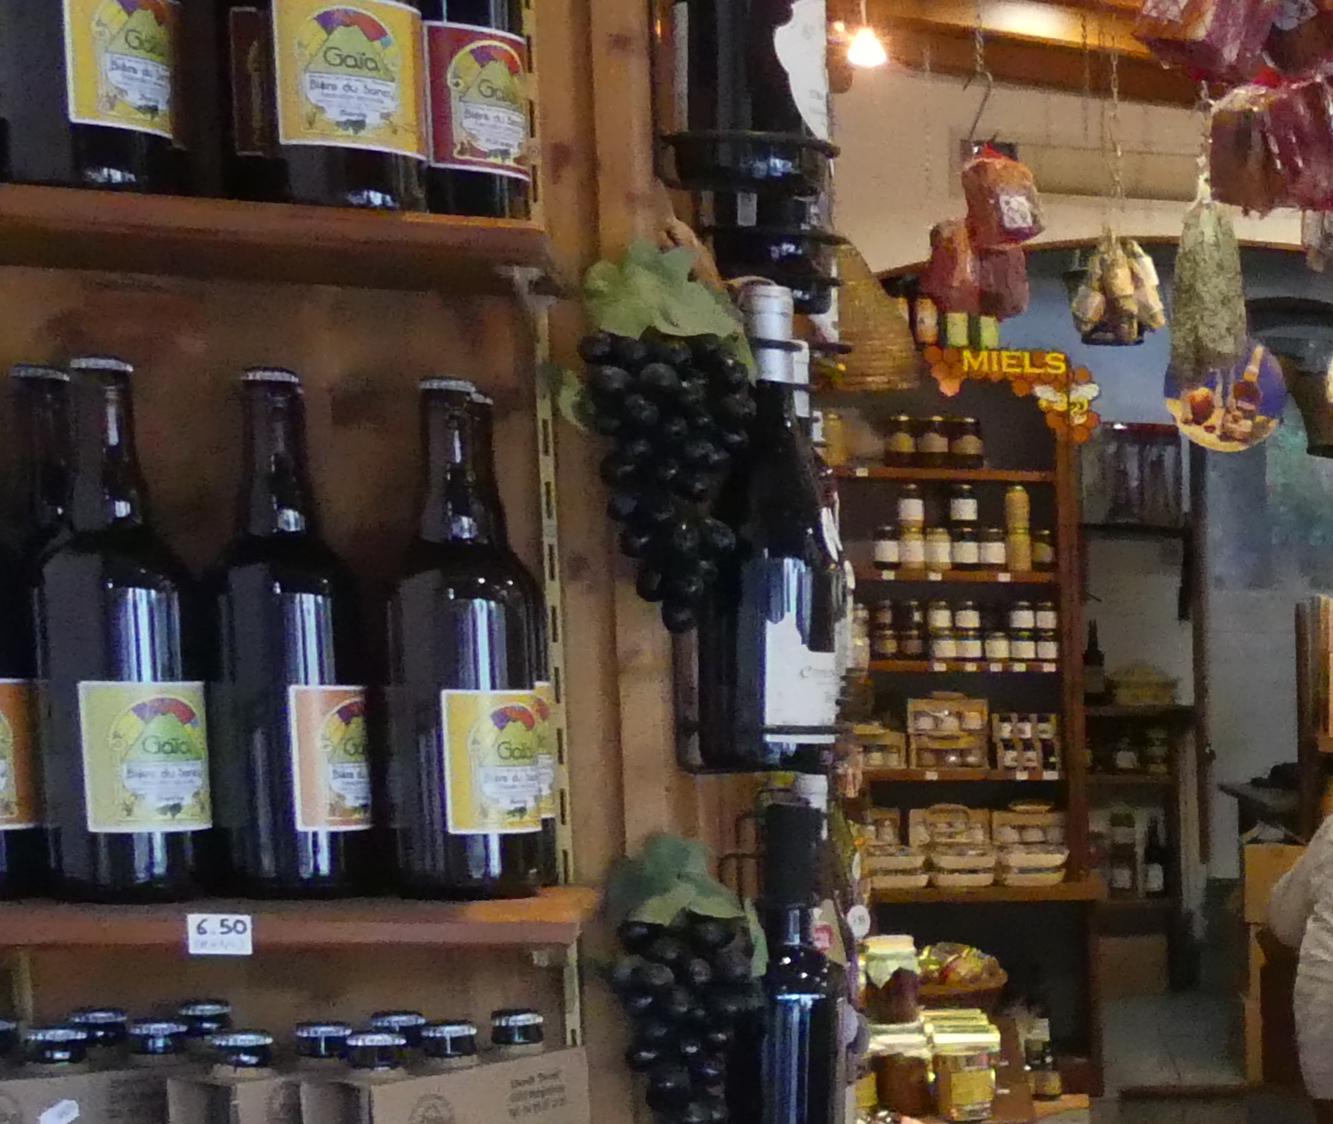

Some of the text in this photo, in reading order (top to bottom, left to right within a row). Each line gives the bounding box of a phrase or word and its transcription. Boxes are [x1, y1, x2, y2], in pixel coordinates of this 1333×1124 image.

[323, 46, 380, 72] Gaïa
[962, 350, 1067, 374] MIELS
[142, 735, 191, 755] Gaïa
